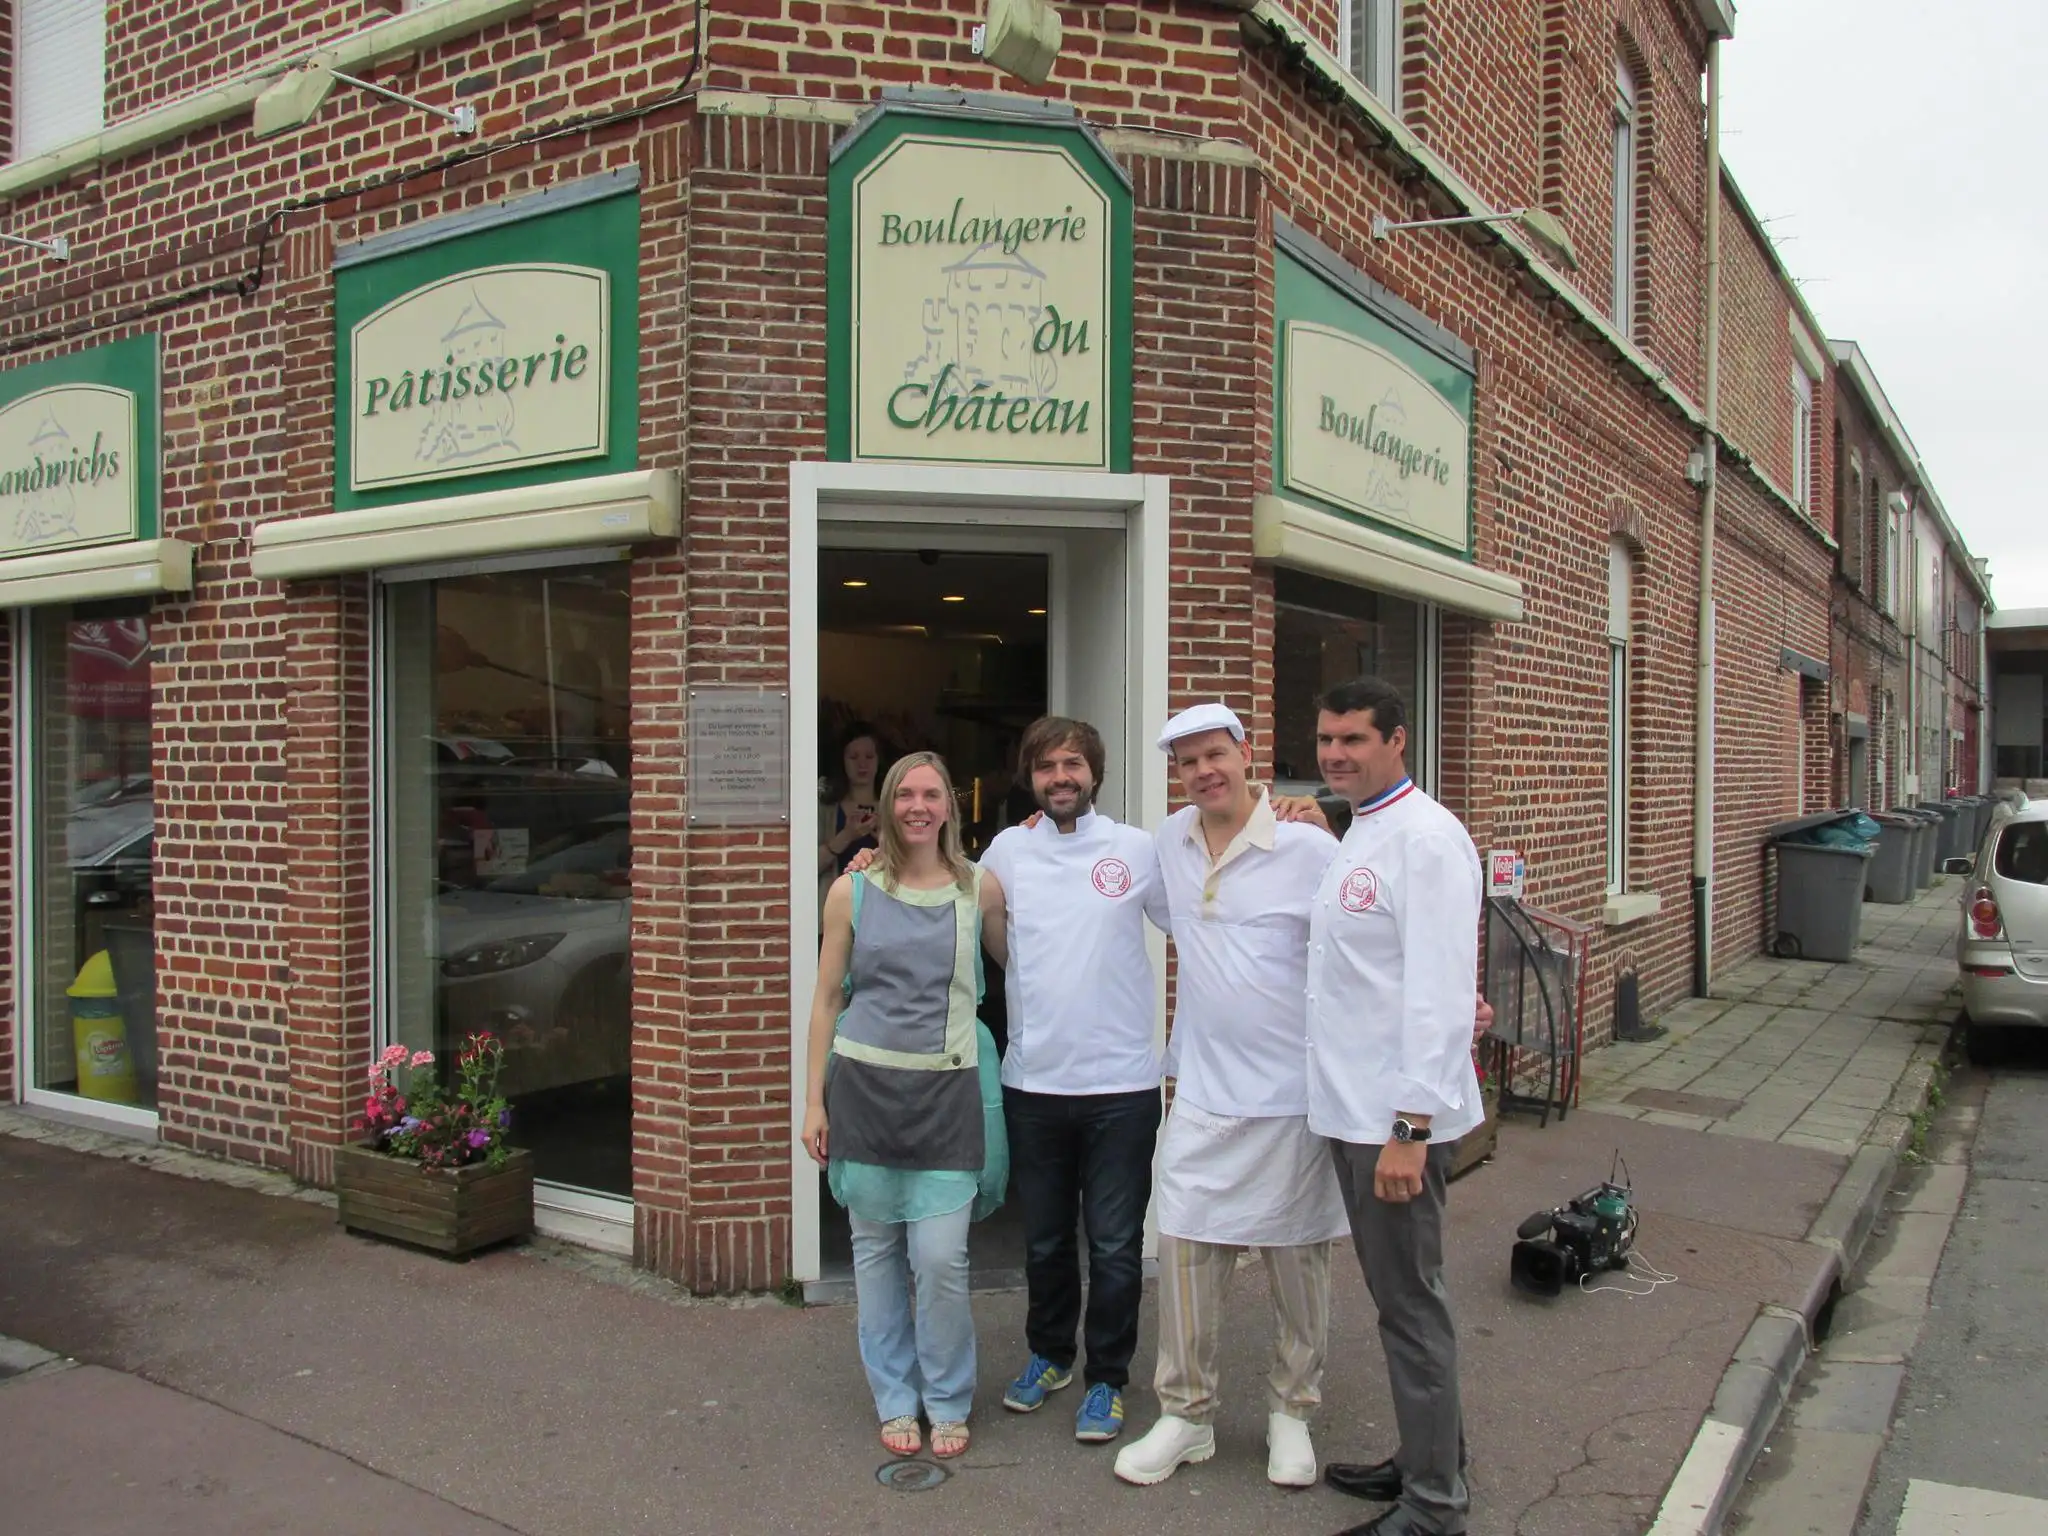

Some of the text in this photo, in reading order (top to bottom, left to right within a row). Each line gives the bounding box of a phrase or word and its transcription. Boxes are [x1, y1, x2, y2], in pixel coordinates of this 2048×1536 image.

[878, 197, 1086, 255] Boulangerie
[1033, 304, 1090, 356] du
[362, 333, 589, 417] Pâtisserie
[887, 363, 1091, 437] Château
[1318, 394, 1450, 486] Boulangerie
